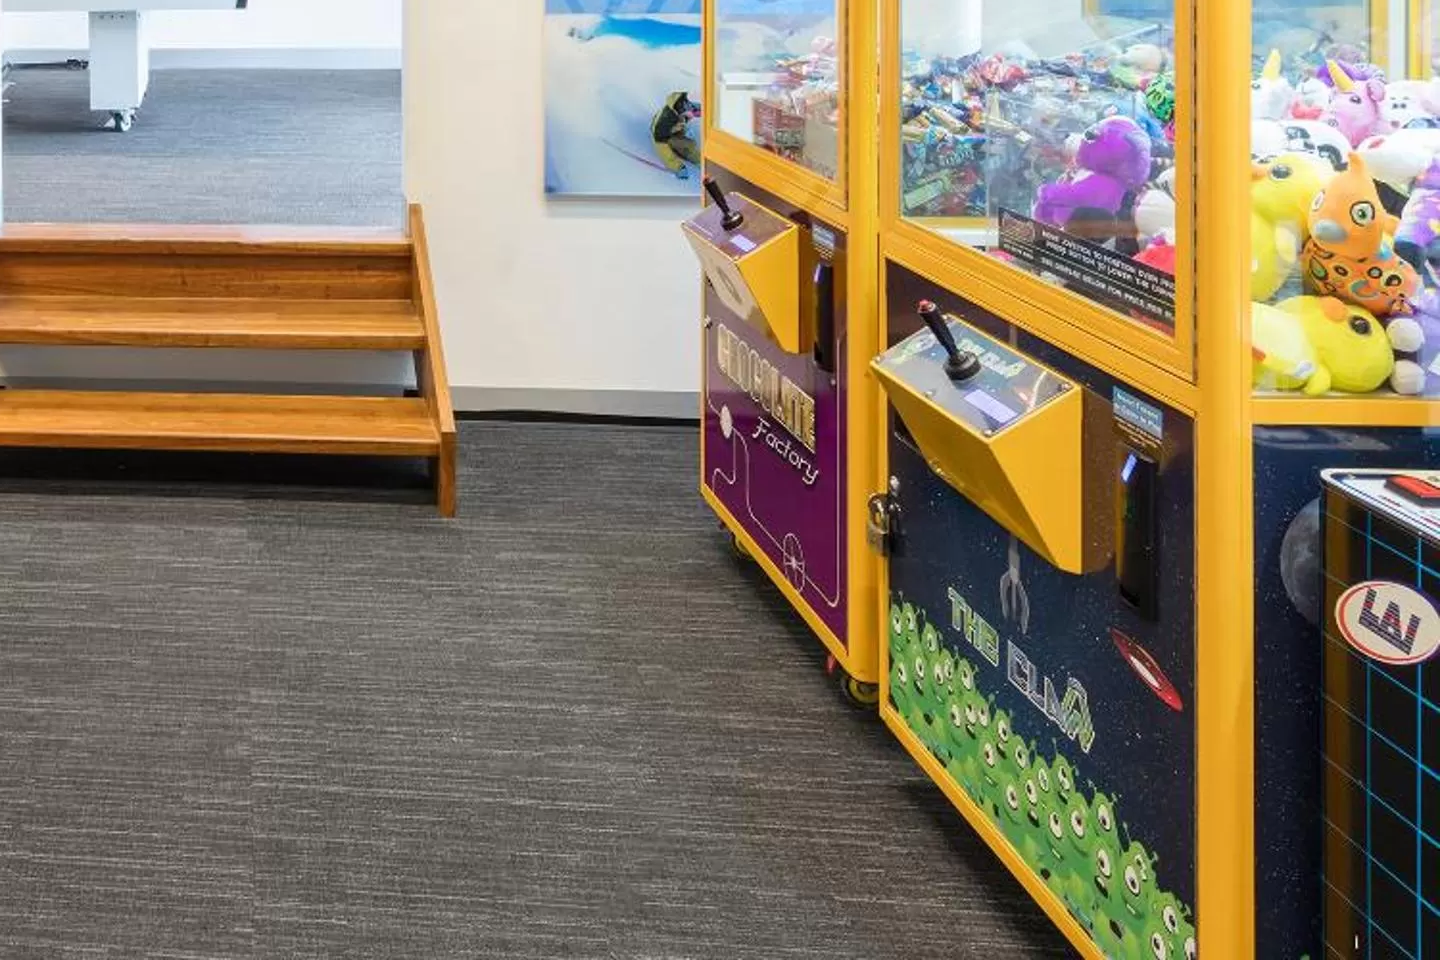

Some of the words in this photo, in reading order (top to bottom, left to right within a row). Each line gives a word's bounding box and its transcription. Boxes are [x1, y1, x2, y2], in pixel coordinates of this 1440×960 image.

[752, 415, 820, 486] Factory
[947, 586, 1000, 667] THE
[1007, 638, 1096, 754] CLAW
